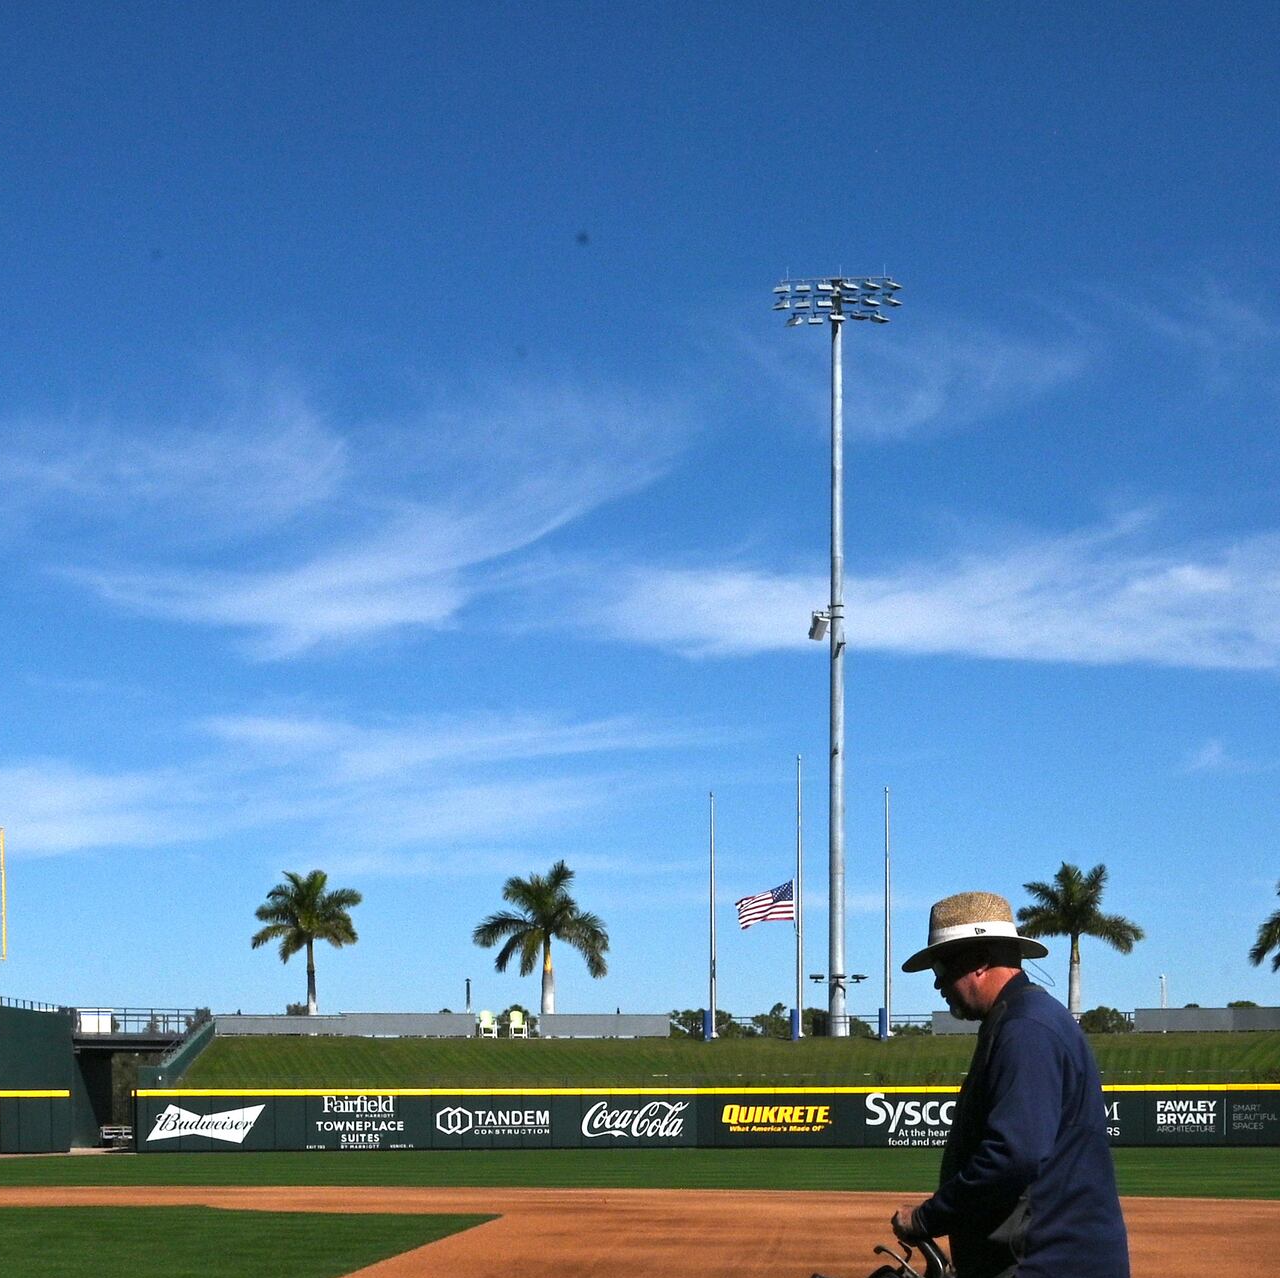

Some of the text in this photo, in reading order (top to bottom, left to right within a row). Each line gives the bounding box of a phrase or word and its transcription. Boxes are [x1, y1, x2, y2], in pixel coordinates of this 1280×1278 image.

[322, 1095, 395, 1113] Fairfield
[1156, 1100, 1217, 1112] FAWLEY
[1232, 1104, 1261, 1112] SMART
[474, 1110, 550, 1125] TANDEM
[581, 1101, 689, 1138] Coca-Cola
[721, 1104, 831, 1125] QUIKRETE
[1156, 1113, 1217, 1125] BRYANT
[156, 1113, 254, 1132] Budweiser
[316, 1121, 405, 1132] TOWNEPLACE
[1232, 1122, 1264, 1130] SPACES
[898, 1128, 909, 1137] At
[910, 1128, 926, 1137] the
[1156, 1125, 1215, 1133] ARCHITECTURE
[341, 1133, 380, 1142] SUITES
[888, 1137, 910, 1146] food
[911, 1137, 930, 1146] and
